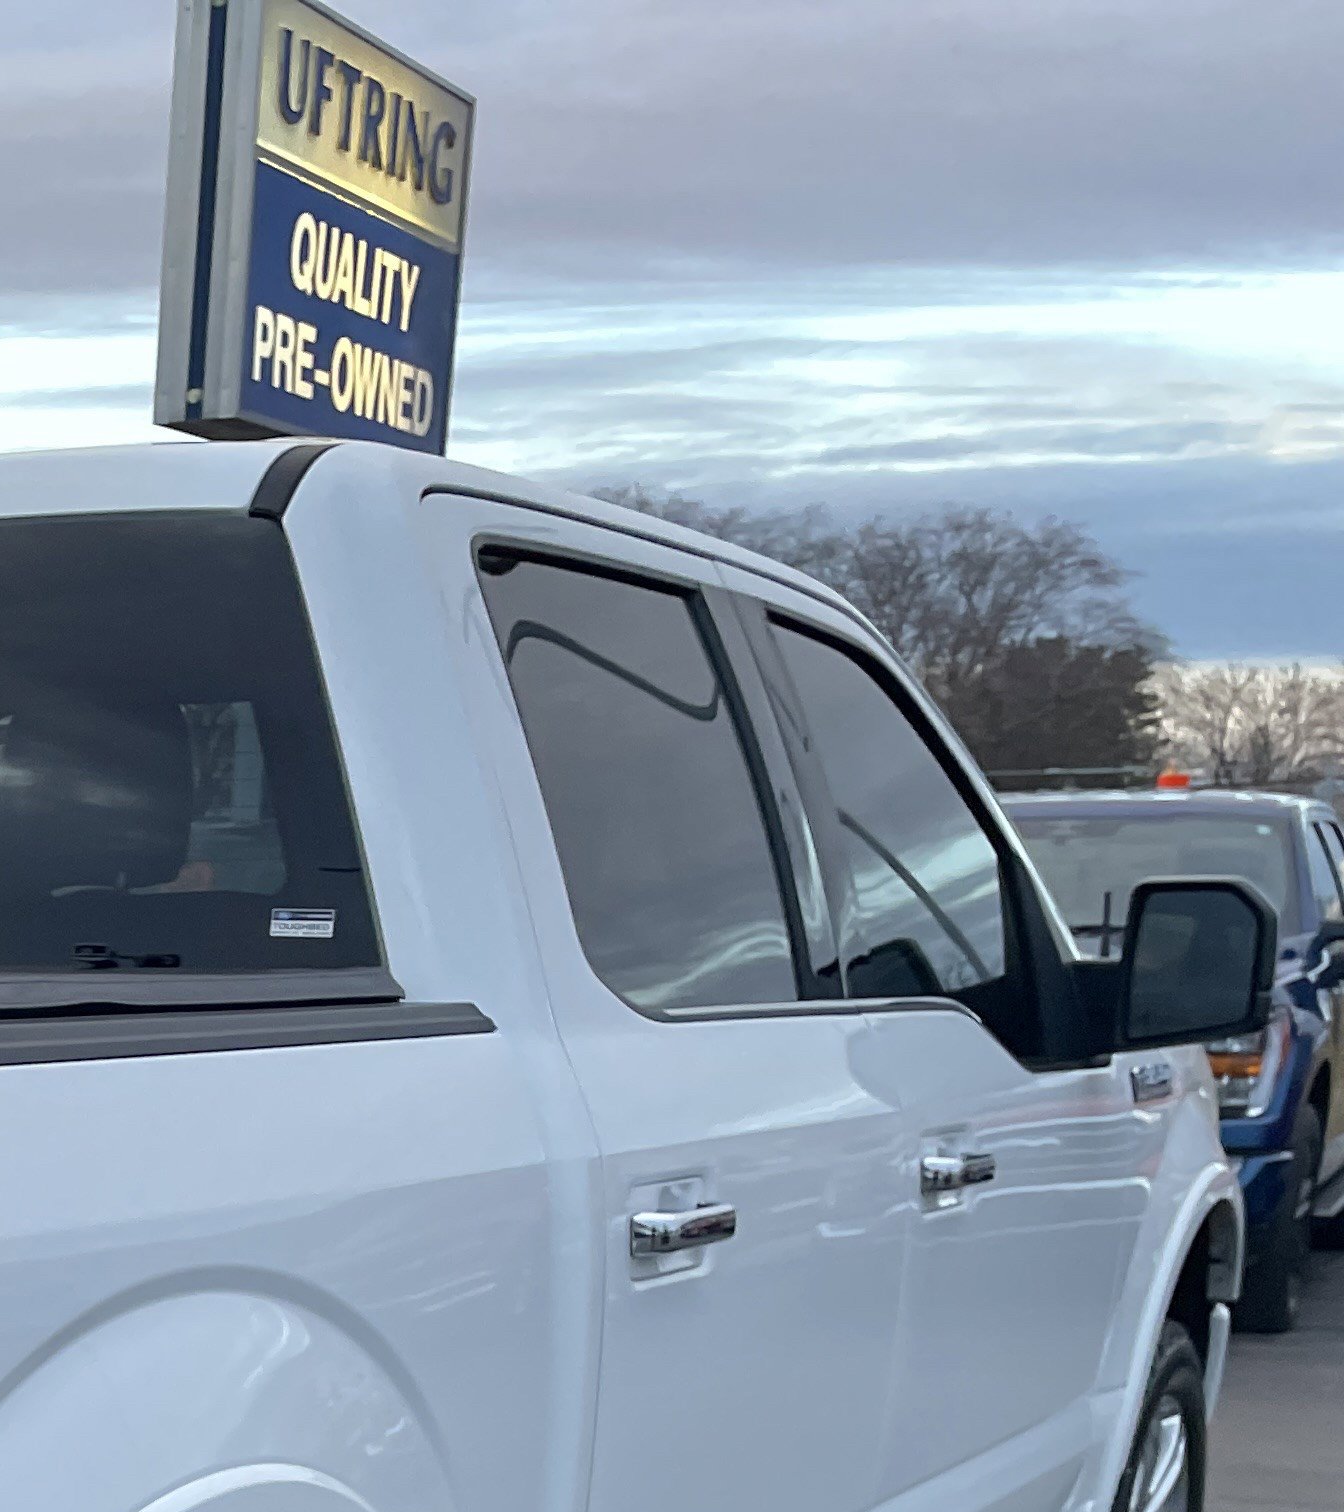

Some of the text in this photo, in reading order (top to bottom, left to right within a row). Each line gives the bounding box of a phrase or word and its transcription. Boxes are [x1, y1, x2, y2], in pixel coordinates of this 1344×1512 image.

[278, 29, 458, 205] UFTRING
[289, 211, 422, 333] QUALITY
[250, 304, 435, 437] PRE-OWNED
